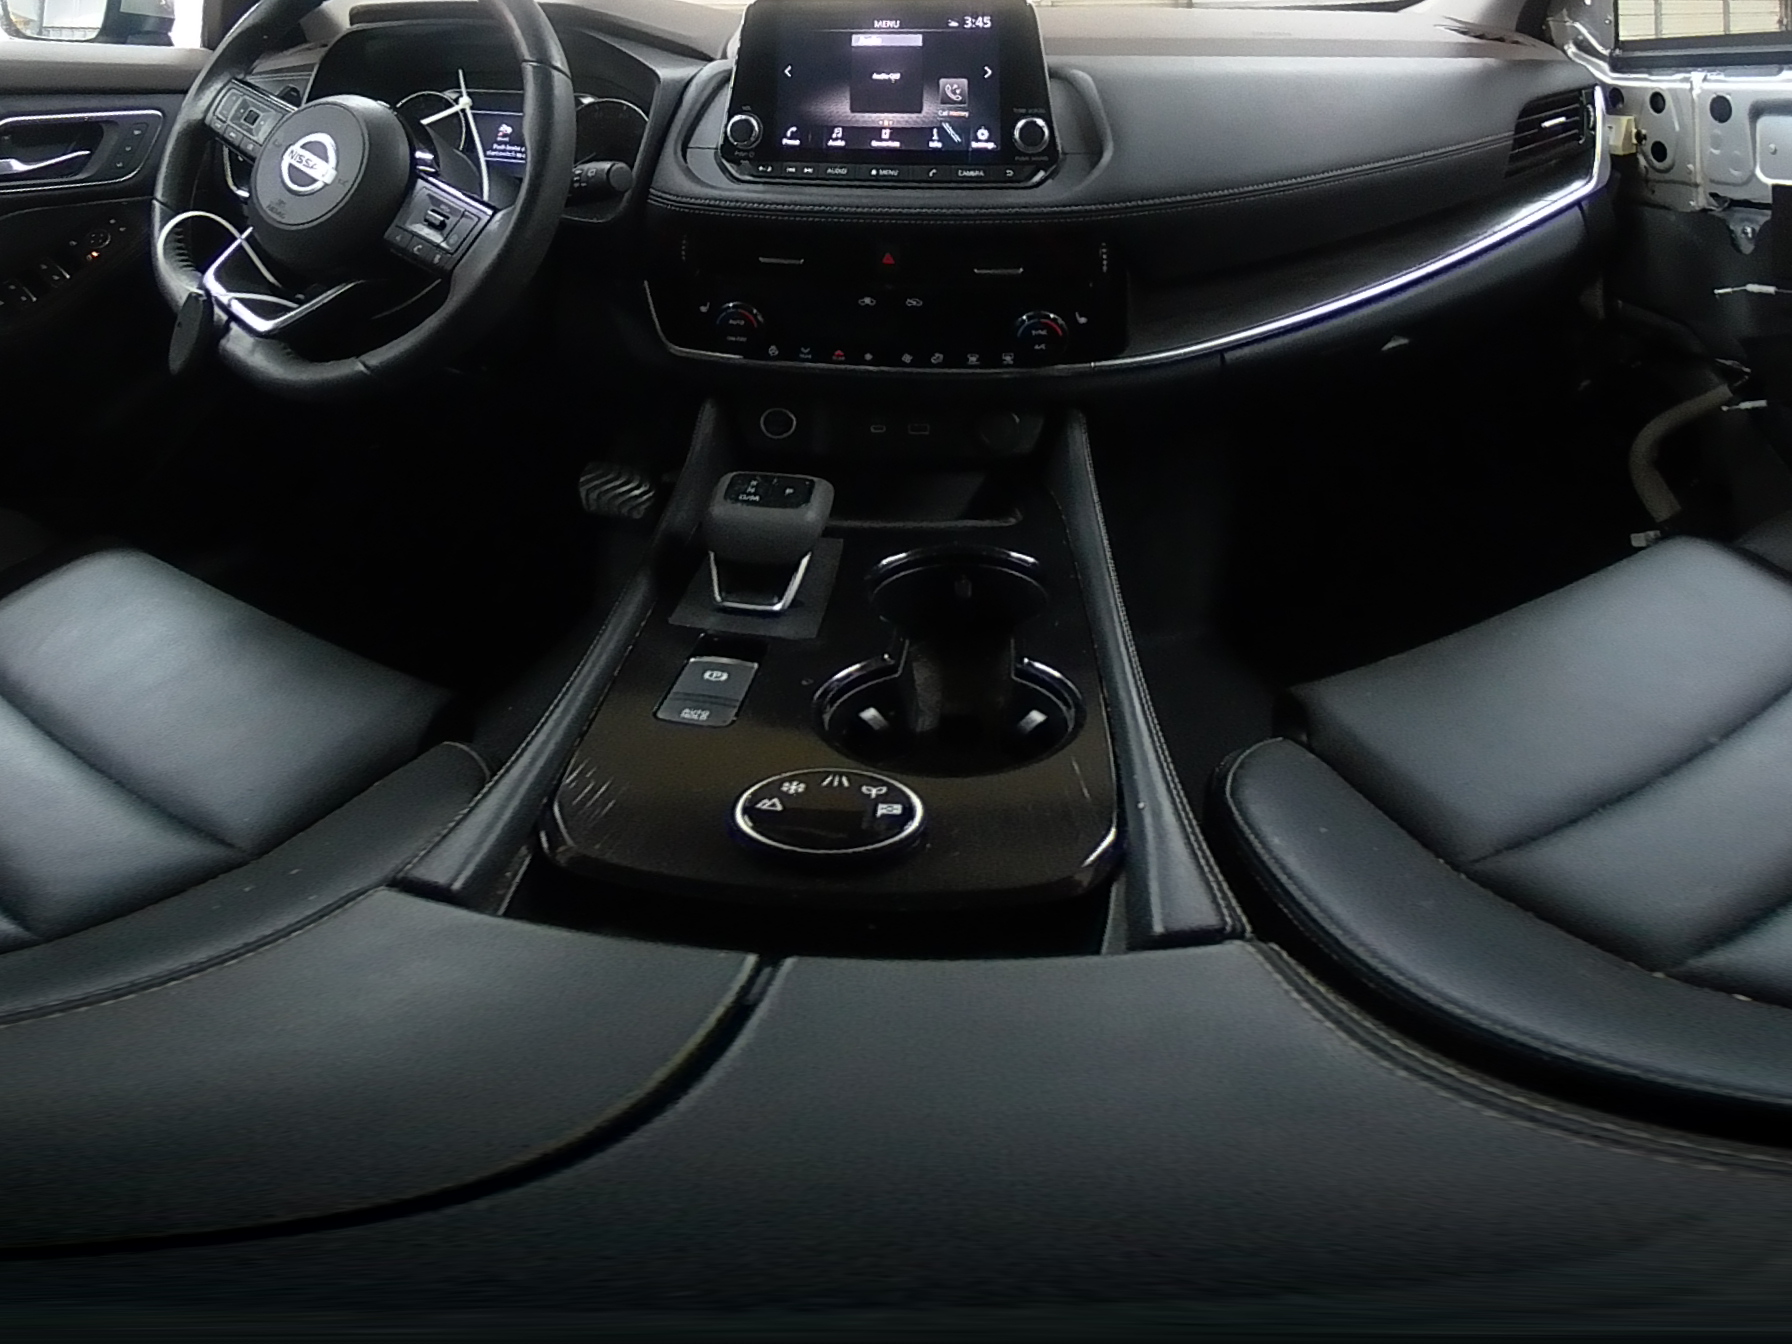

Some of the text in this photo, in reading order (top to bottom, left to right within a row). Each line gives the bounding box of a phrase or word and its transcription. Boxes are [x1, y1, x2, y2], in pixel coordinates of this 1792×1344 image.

[873, 19, 900, 29] MENU
[963, 15, 992, 29] 3:45
[826, 167, 848, 175] AUDIO
[879, 168, 899, 176] MENU
